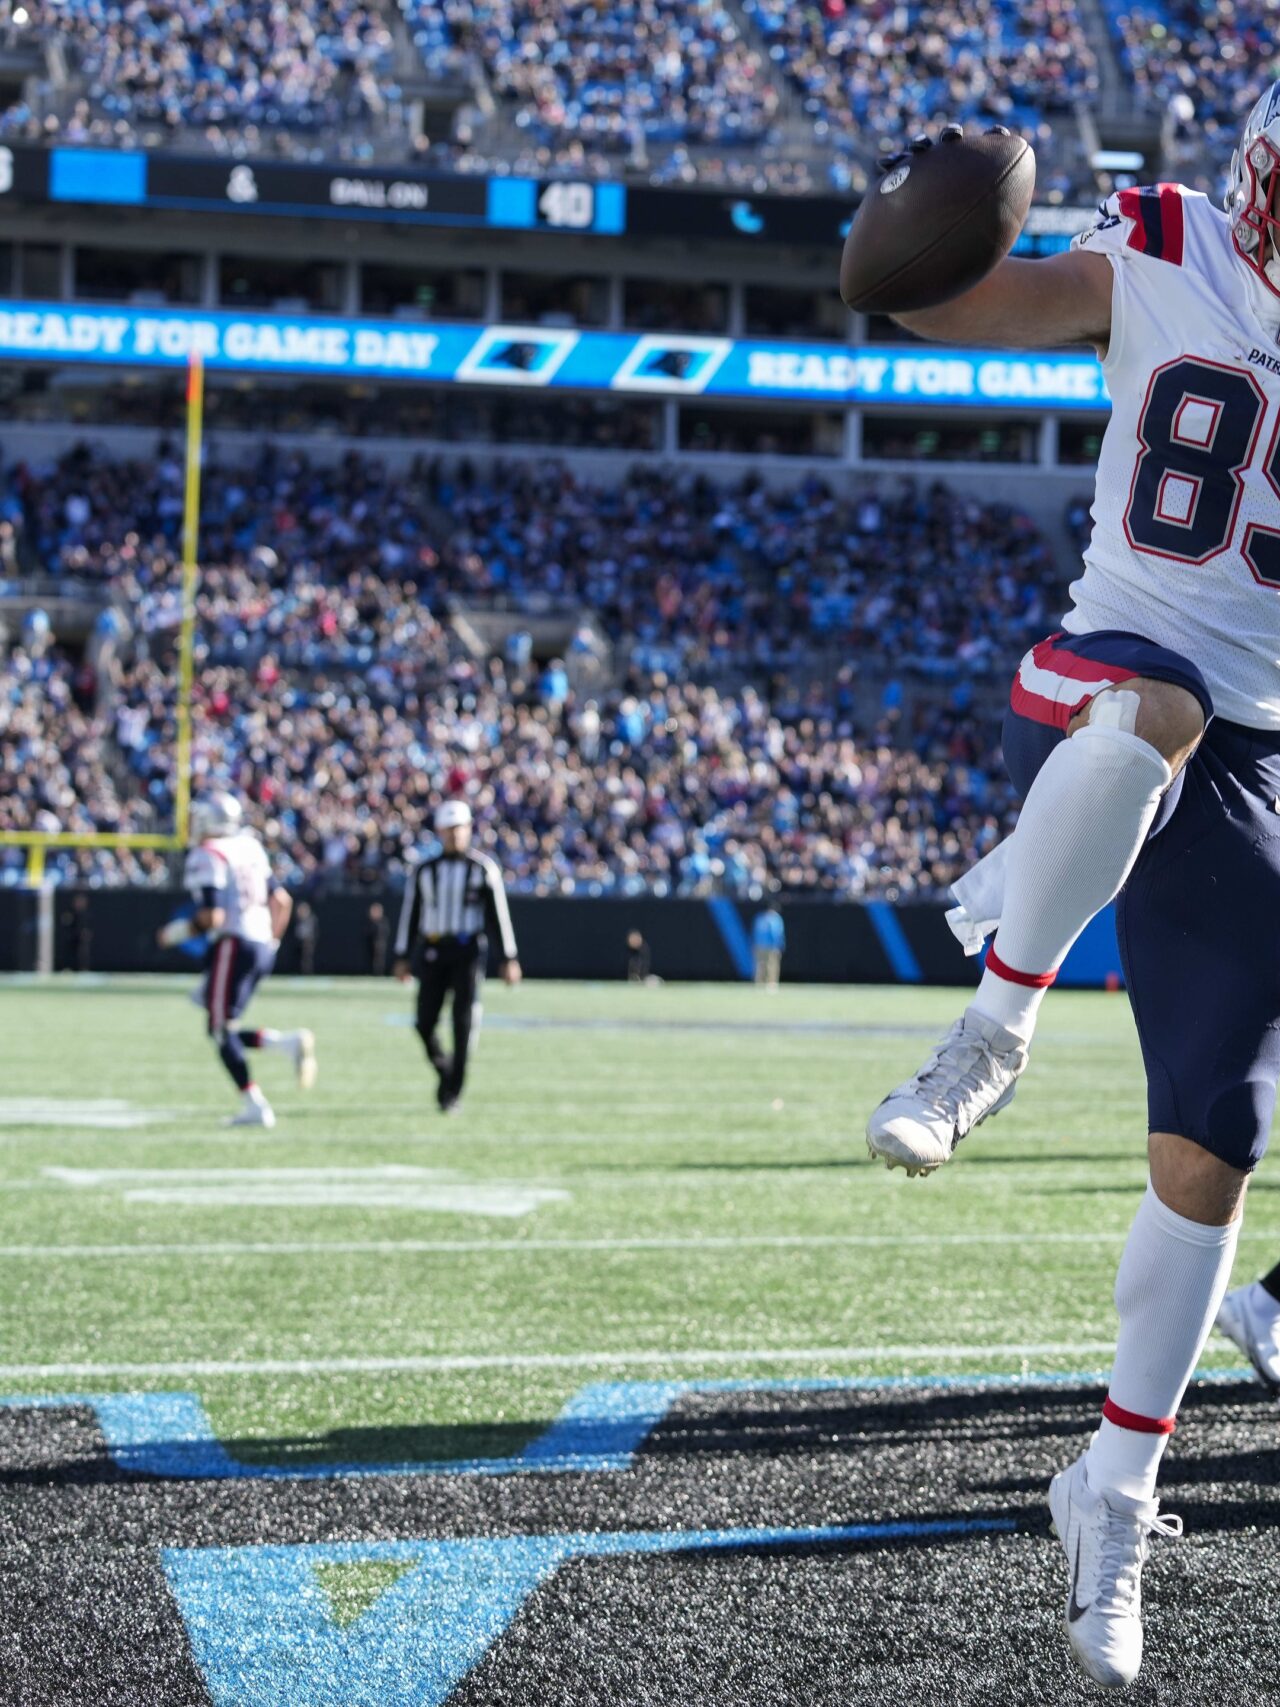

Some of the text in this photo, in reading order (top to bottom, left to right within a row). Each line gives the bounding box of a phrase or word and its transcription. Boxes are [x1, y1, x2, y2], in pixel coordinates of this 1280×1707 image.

[226, 164, 259, 203] &
[329, 178, 428, 209] BALL ON
[539, 181, 593, 228] 40
[132, 319, 220, 359] FOR
[222, 323, 350, 366] GAME
[353, 329, 440, 370] DAY
[747, 352, 1099, 401] READY FOR GAME
